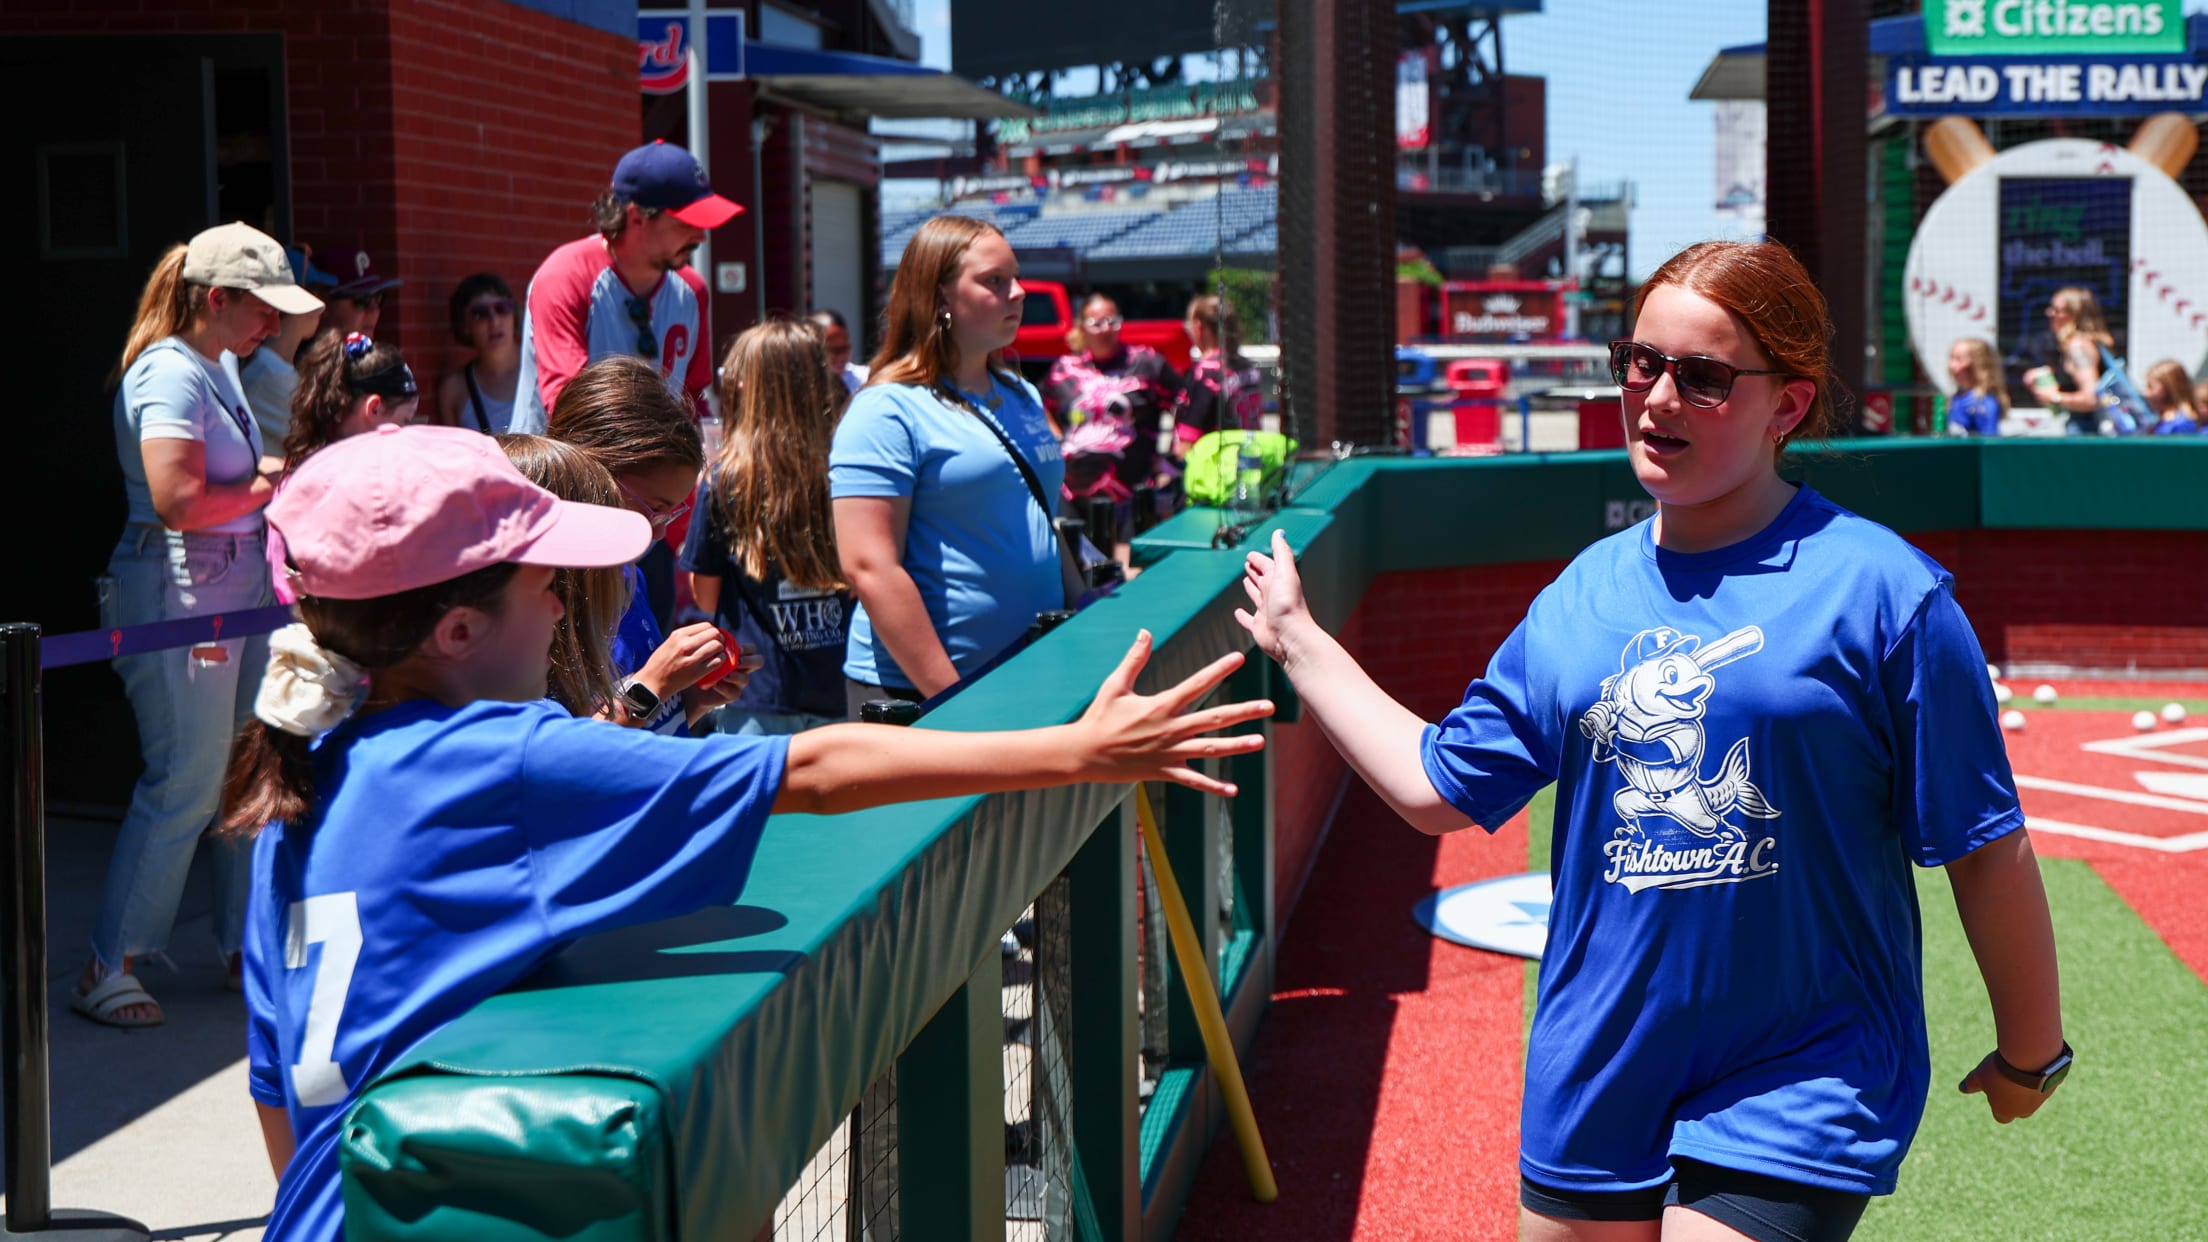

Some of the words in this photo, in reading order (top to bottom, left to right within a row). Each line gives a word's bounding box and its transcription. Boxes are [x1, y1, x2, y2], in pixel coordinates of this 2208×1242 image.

[1994, 0, 2163, 36] Citizens
[637, 22, 684, 68] rd
[1898, 66, 1999, 102] LEAD
[2004, 66, 2081, 102] THE
[2087, 64, 2208, 102] RALLY
[2002, 239, 2050, 266] the
[1454, 312, 1549, 333] Budweiser
[1655, 631, 1671, 649] F
[1603, 838, 1716, 884] Fishtown
[1713, 837, 1780, 875] A.C.
[285, 891, 364, 1108] 7
